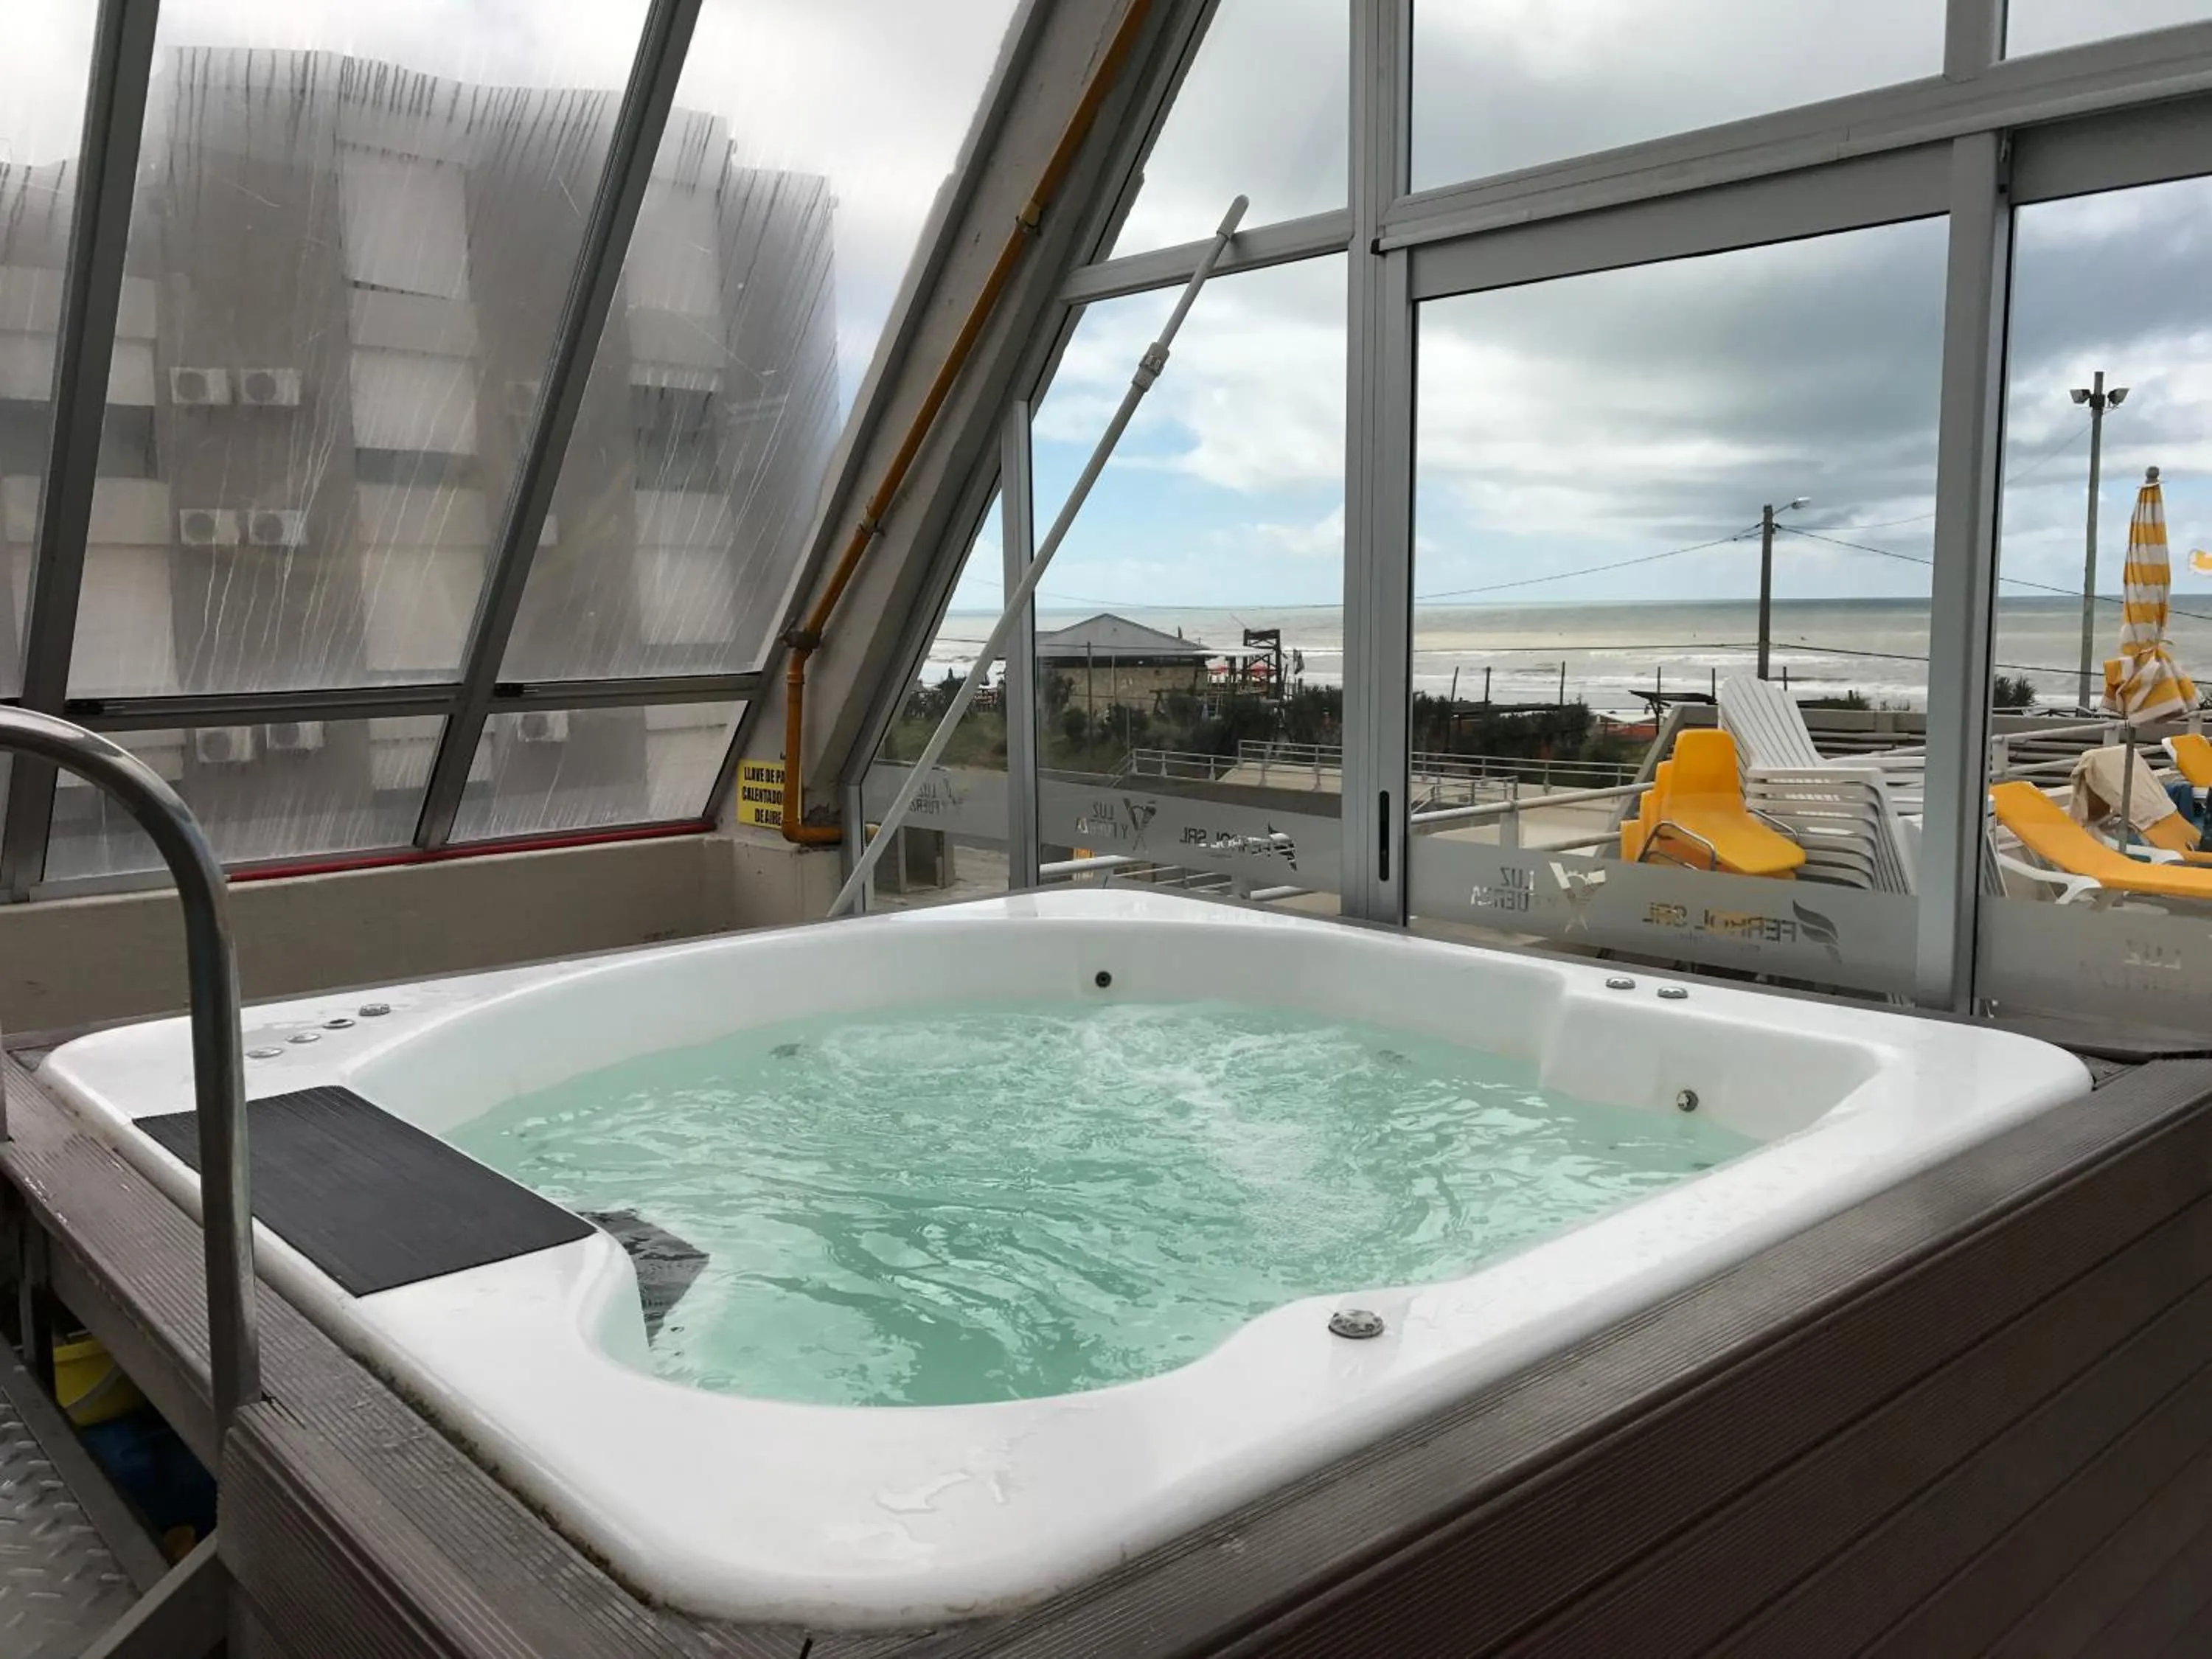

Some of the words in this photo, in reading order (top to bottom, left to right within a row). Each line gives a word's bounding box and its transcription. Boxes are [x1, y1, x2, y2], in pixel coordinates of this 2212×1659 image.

[744, 766, 764, 782] LLAVE
[765, 768, 775, 783] DE
[776, 769, 785, 784] PA
[741, 785, 785, 805] CALENTADO
[754, 809, 765, 824] DE
[765, 810, 781, 826] AIRE
